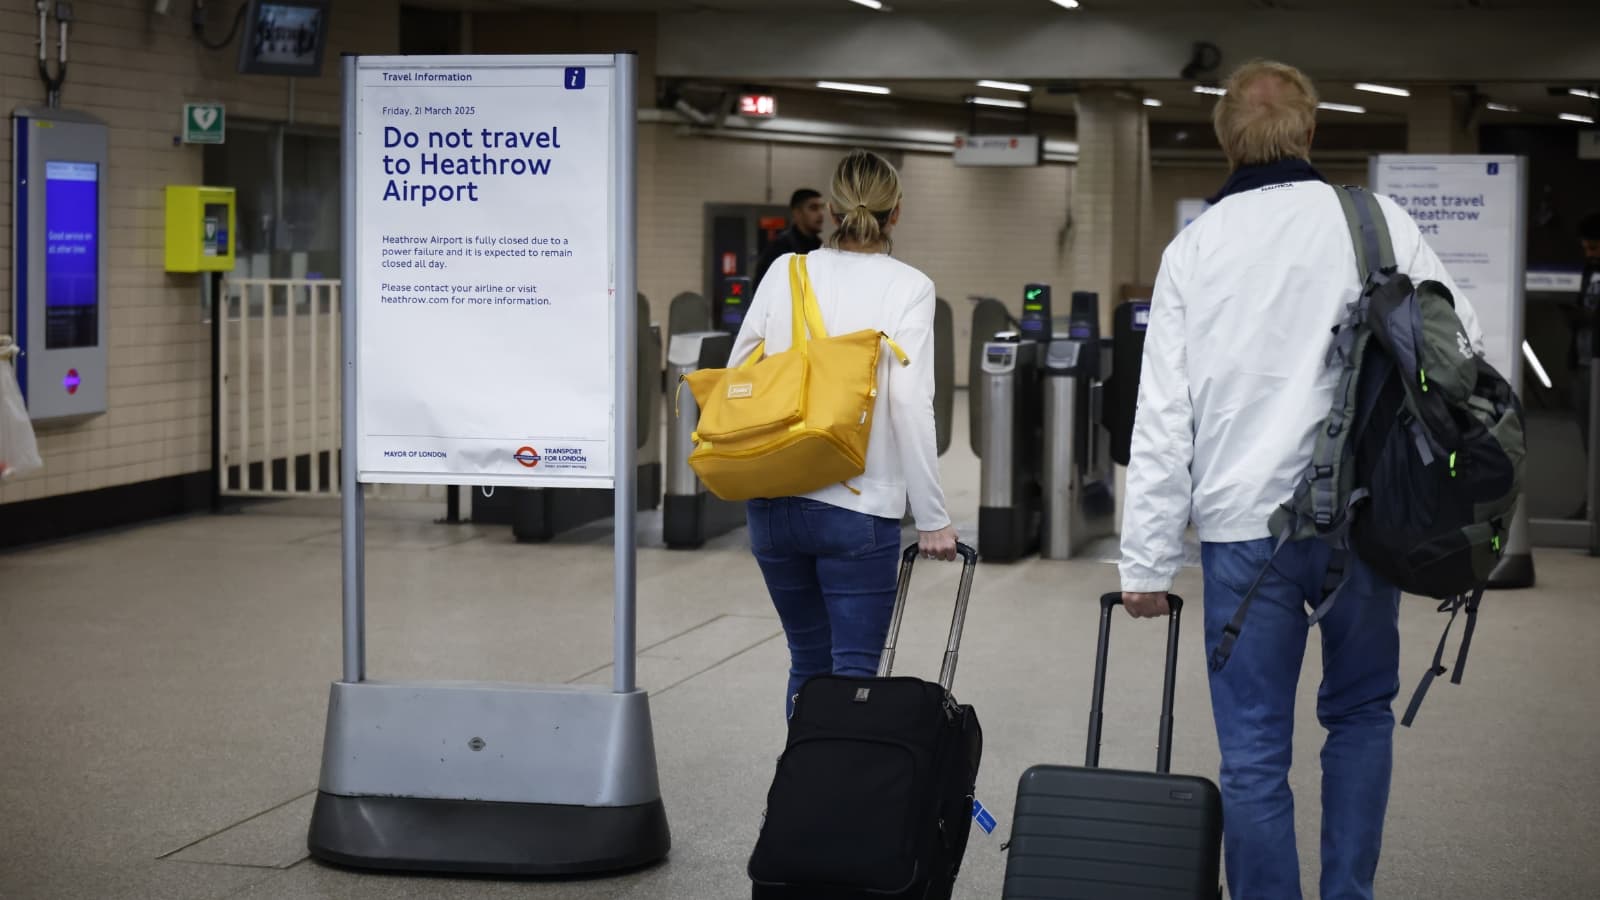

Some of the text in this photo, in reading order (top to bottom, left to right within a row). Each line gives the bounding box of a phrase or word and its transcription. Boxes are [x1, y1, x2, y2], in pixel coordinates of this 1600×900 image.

[382, 72, 473, 82] Travel Information
[414, 106, 422, 115] 21
[424, 106, 452, 115] March
[454, 106, 476, 115] 2025
[383, 126, 561, 149] Do not travel
[382, 152, 552, 176] to Heathrow
[382, 179, 479, 207] Airport
[1412, 194, 1438, 207] not
[1442, 193, 1485, 208] travel
[381, 235, 569, 247] Heathrow Airport is fully closed due to a
[381, 247, 573, 259] power failure and it is expected to remain
[381, 259, 448, 270] closed all day.
[381, 283, 537, 295] Please contact your airline or visit
[380, 295, 552, 306] heathrow.com for more information.
[383, 450, 448, 459] MAYOR OF LONDON
